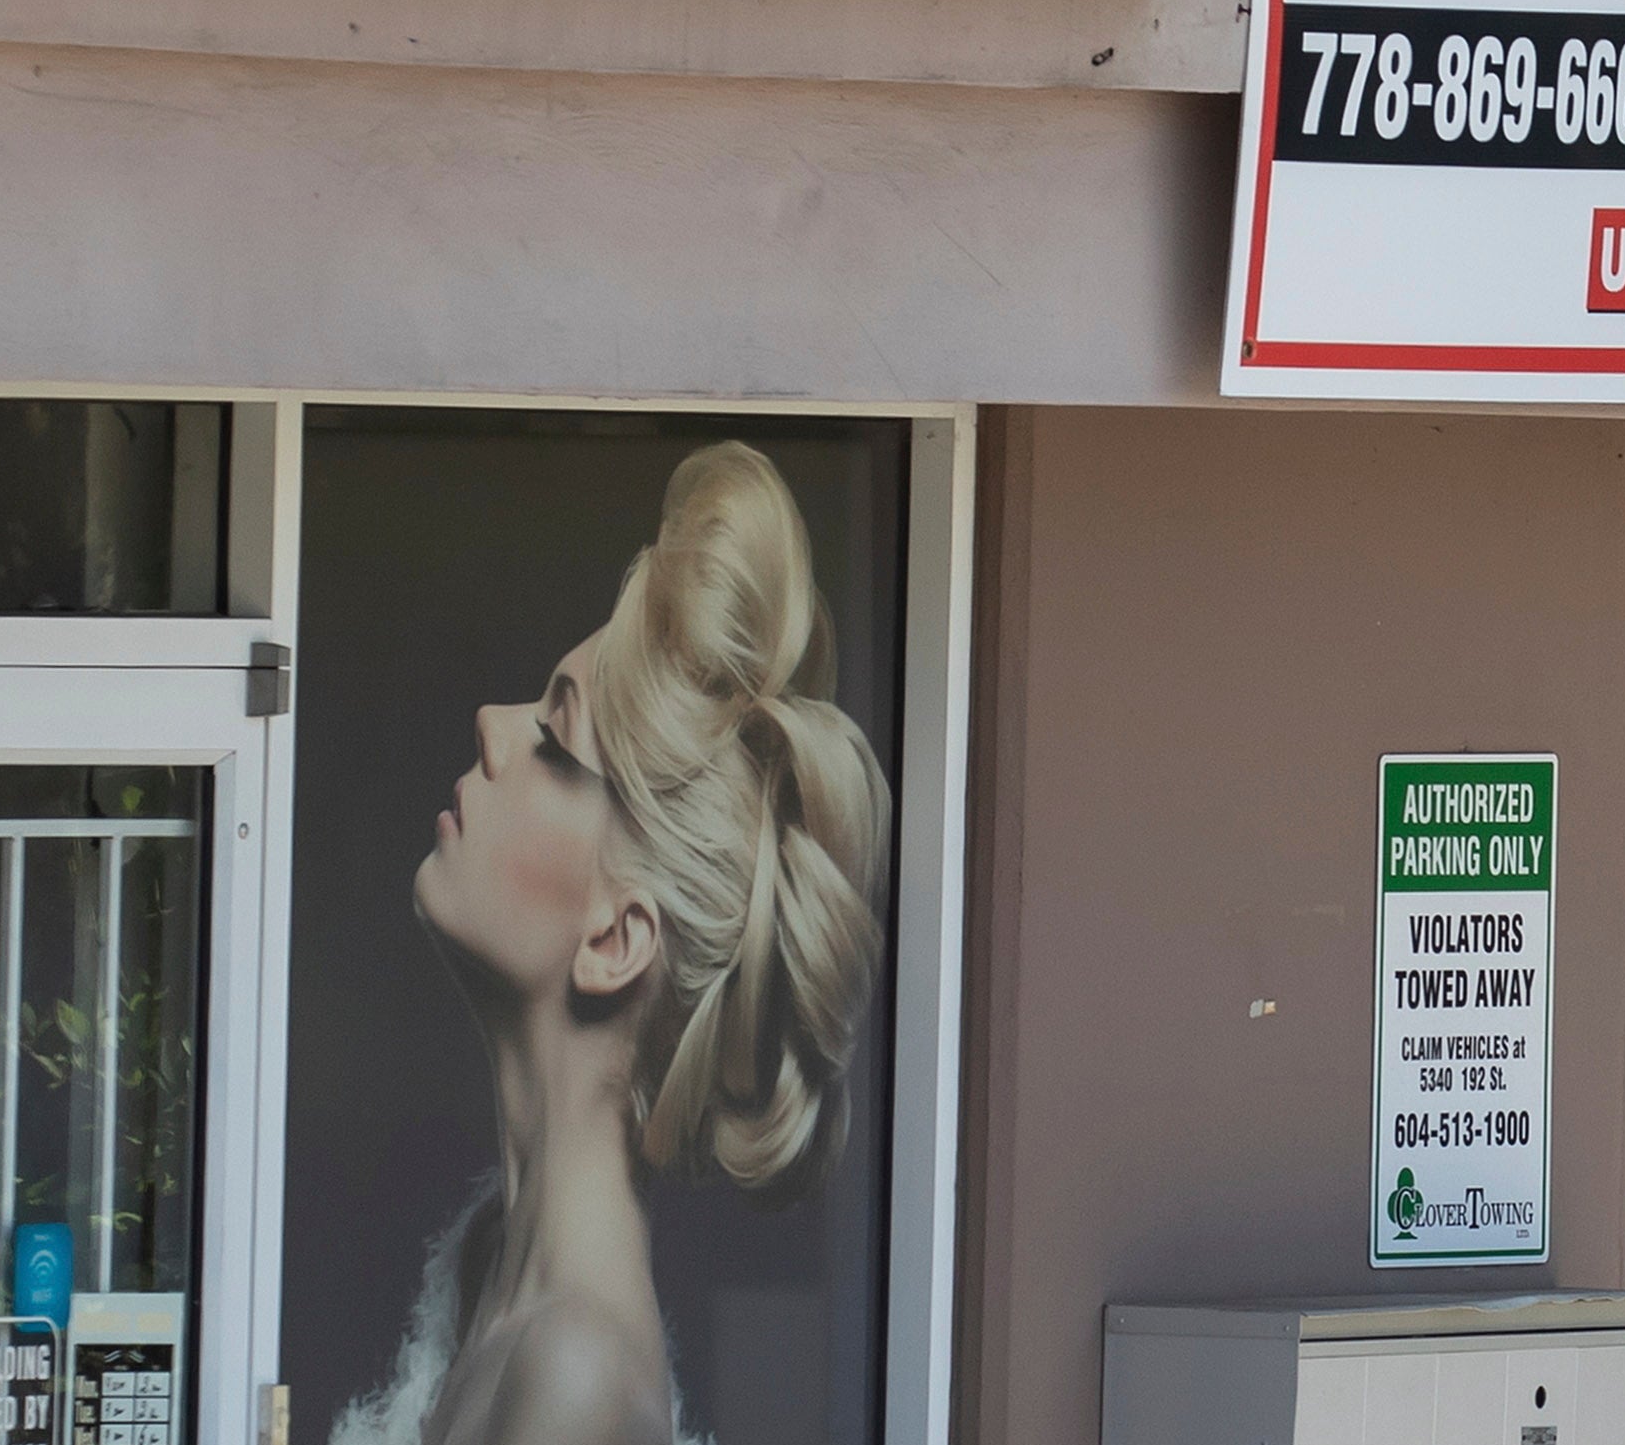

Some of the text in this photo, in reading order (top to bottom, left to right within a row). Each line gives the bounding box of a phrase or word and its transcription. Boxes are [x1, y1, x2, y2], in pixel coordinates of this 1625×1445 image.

[1403, 783, 1534, 824] AUTHORIZED
[1390, 835, 1544, 876] PARKING ONLY
[1409, 913, 1524, 954] VIOLATORS
[1395, 968, 1536, 1009] TOWED AWAY
[1401, 1035, 1526, 1061] CLAIM VEHICLES at
[1419, 1065, 1507, 1092] 5340 192 St.
[1394, 1110, 1530, 1149] 604-513-1900
[23, 1394, 51, 1430] BY
